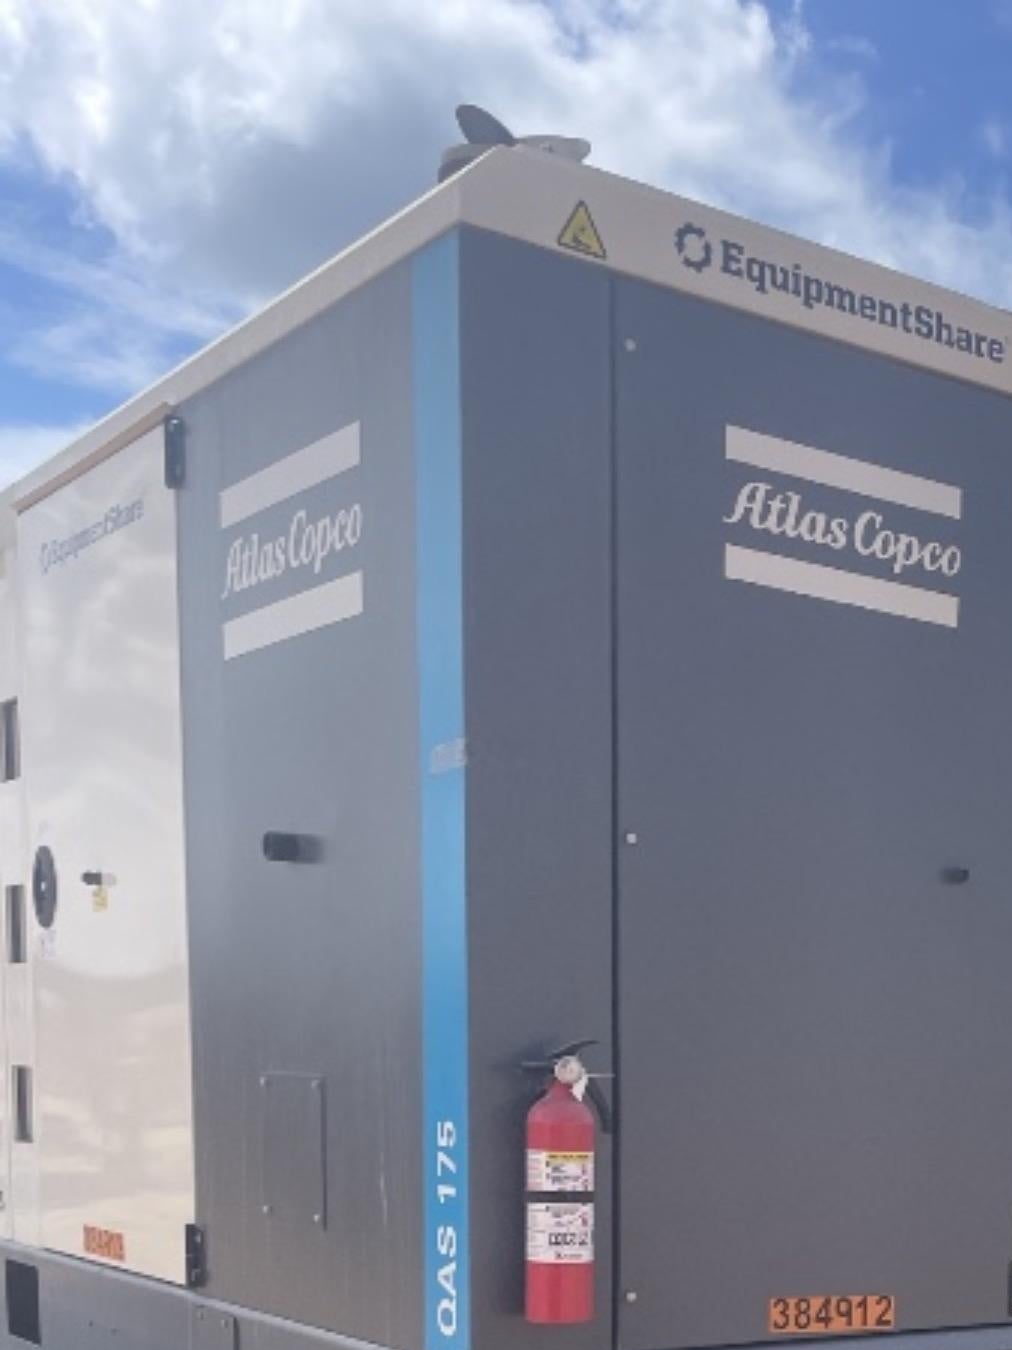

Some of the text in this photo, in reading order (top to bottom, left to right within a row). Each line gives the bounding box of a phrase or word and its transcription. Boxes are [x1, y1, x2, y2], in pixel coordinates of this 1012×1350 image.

[720, 239, 1005, 363] EquipmentShare
[221, 503, 362, 600] Atlas Copco
[723, 482, 961, 577] Atlas Copco
[436, 1120, 457, 1337] QAS 175
[773, 1295, 893, 1330] 384912
